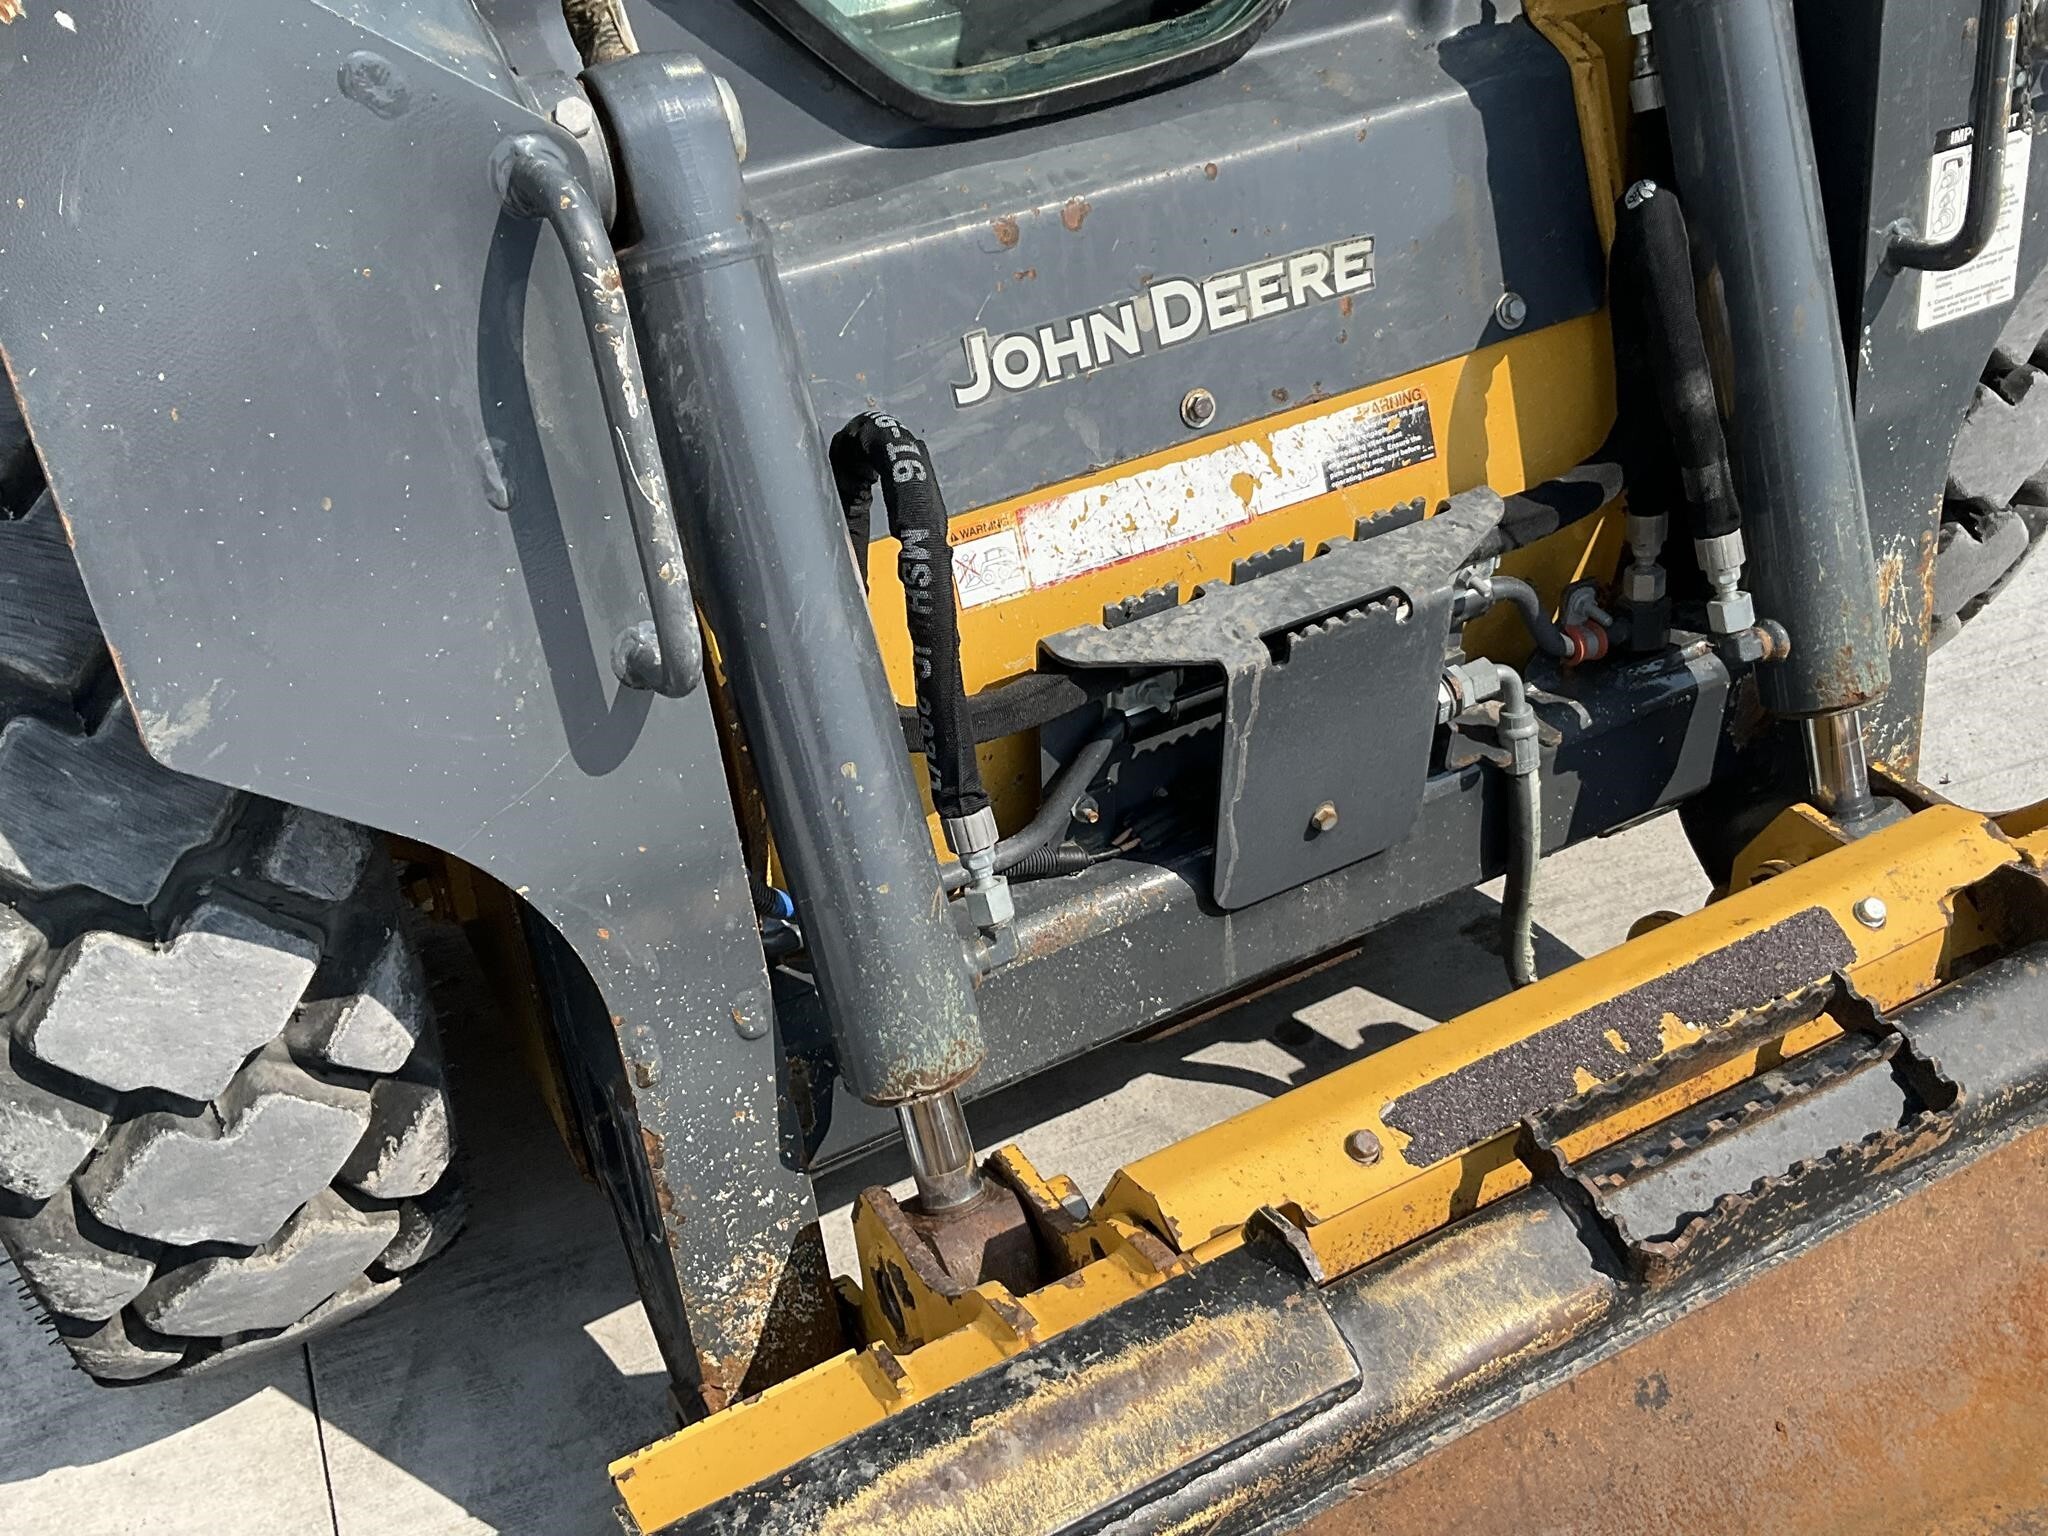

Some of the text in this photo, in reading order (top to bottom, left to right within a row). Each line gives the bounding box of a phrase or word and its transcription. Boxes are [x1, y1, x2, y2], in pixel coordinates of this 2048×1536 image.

[954, 239, 1373, 406] JOHN DEERE
[1399, 445, 1421, 455] before
